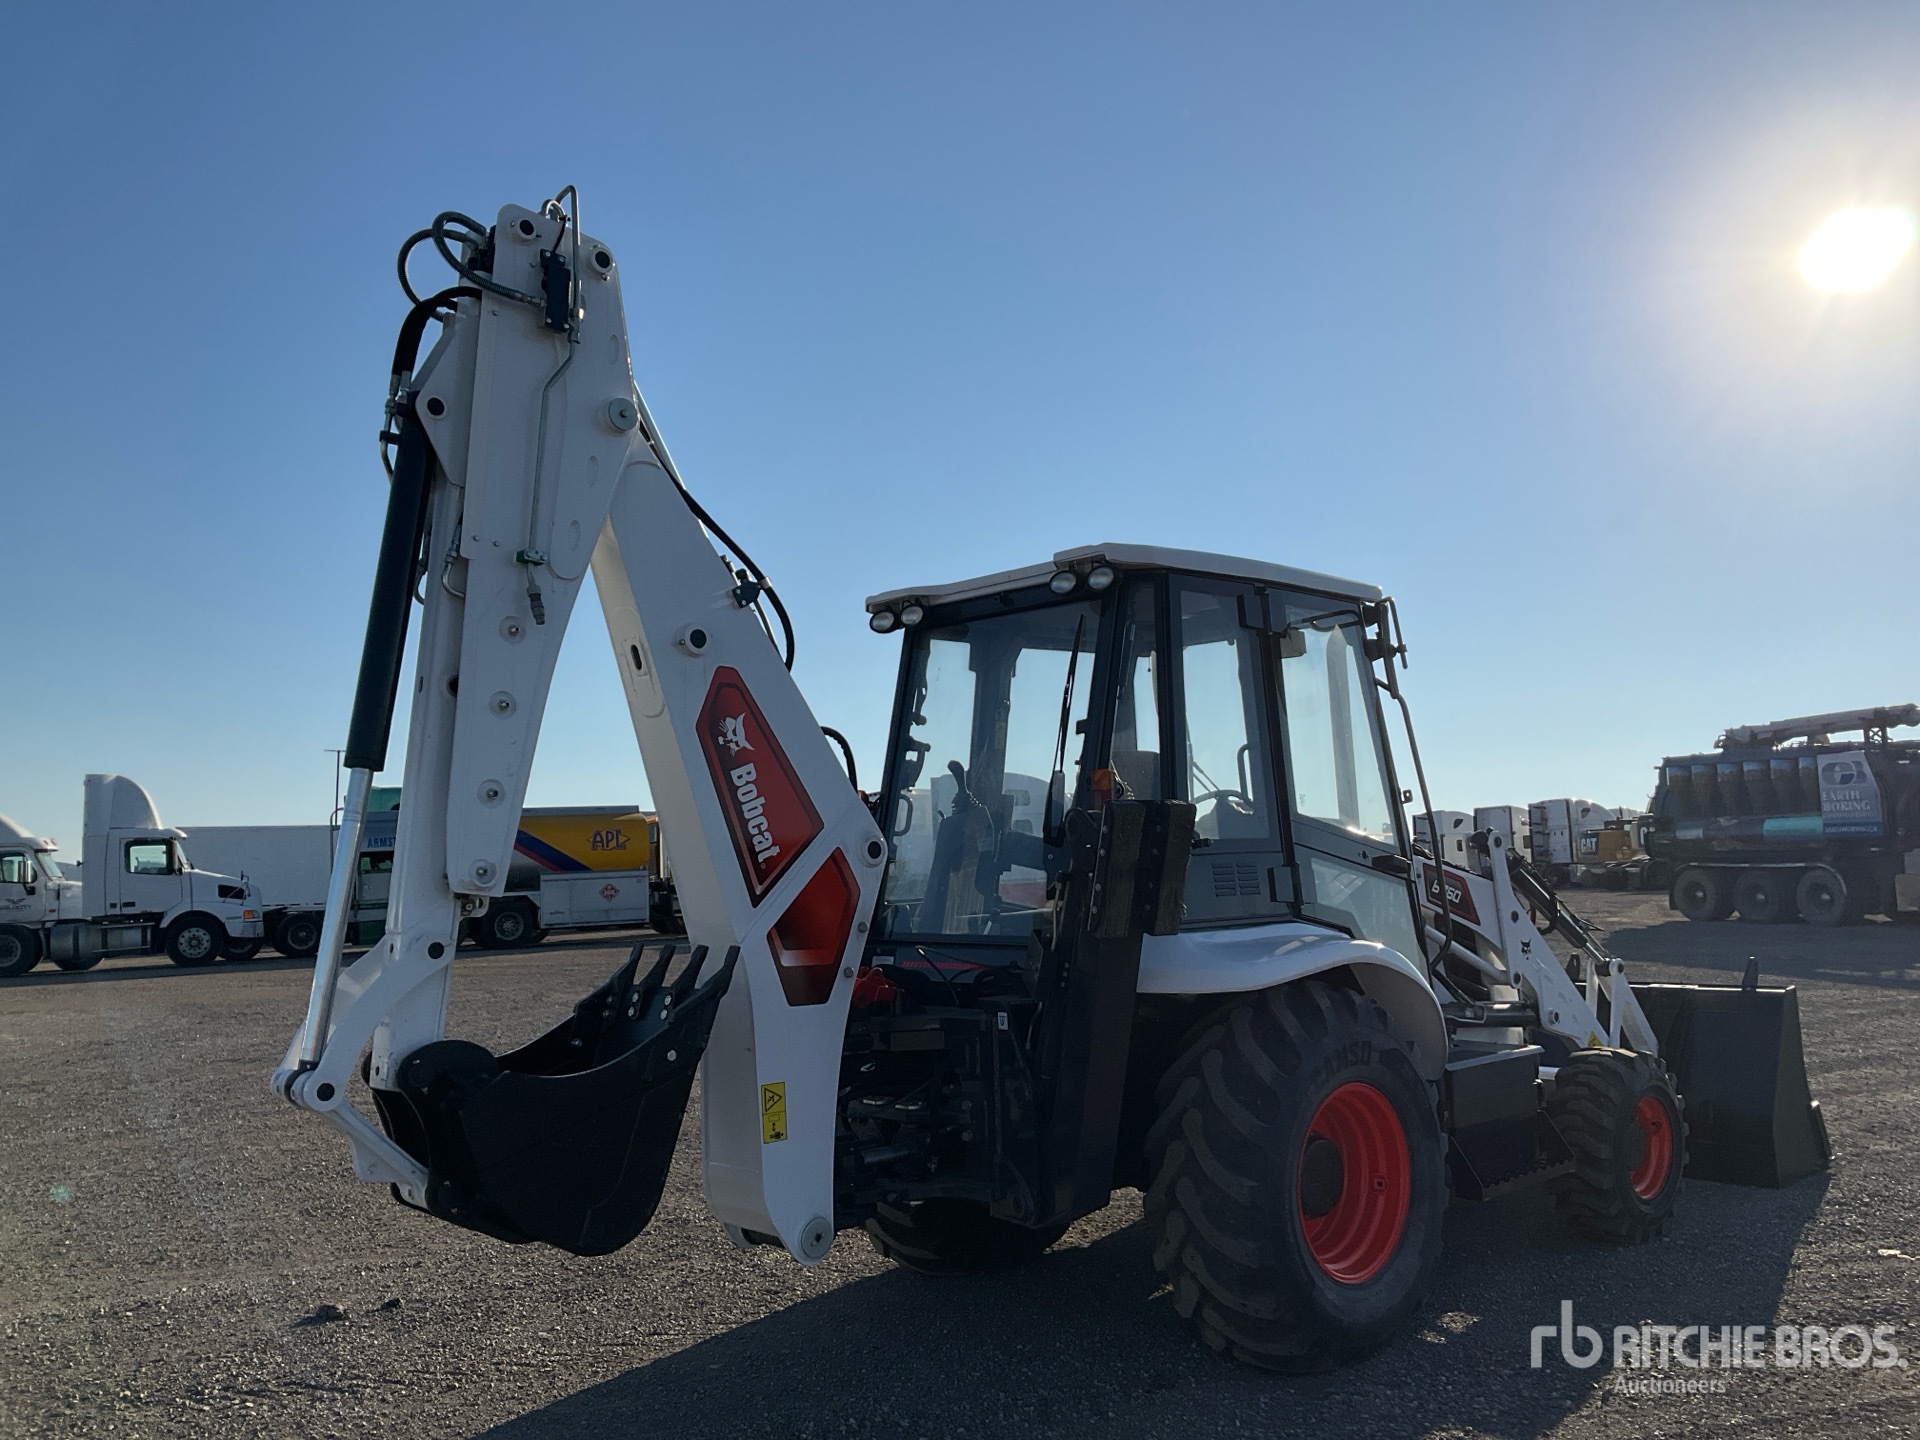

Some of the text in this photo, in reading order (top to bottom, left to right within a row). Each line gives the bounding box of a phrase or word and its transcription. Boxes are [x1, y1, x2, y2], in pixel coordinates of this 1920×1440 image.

[1822, 789, 1860, 801] EARTH
[729, 762, 781, 863] Bobcat
[1823, 799, 1871, 812] BORING
[591, 828, 627, 850] APL
[1581, 837, 1597, 852] CAT
[1431, 879, 1462, 904] b60
